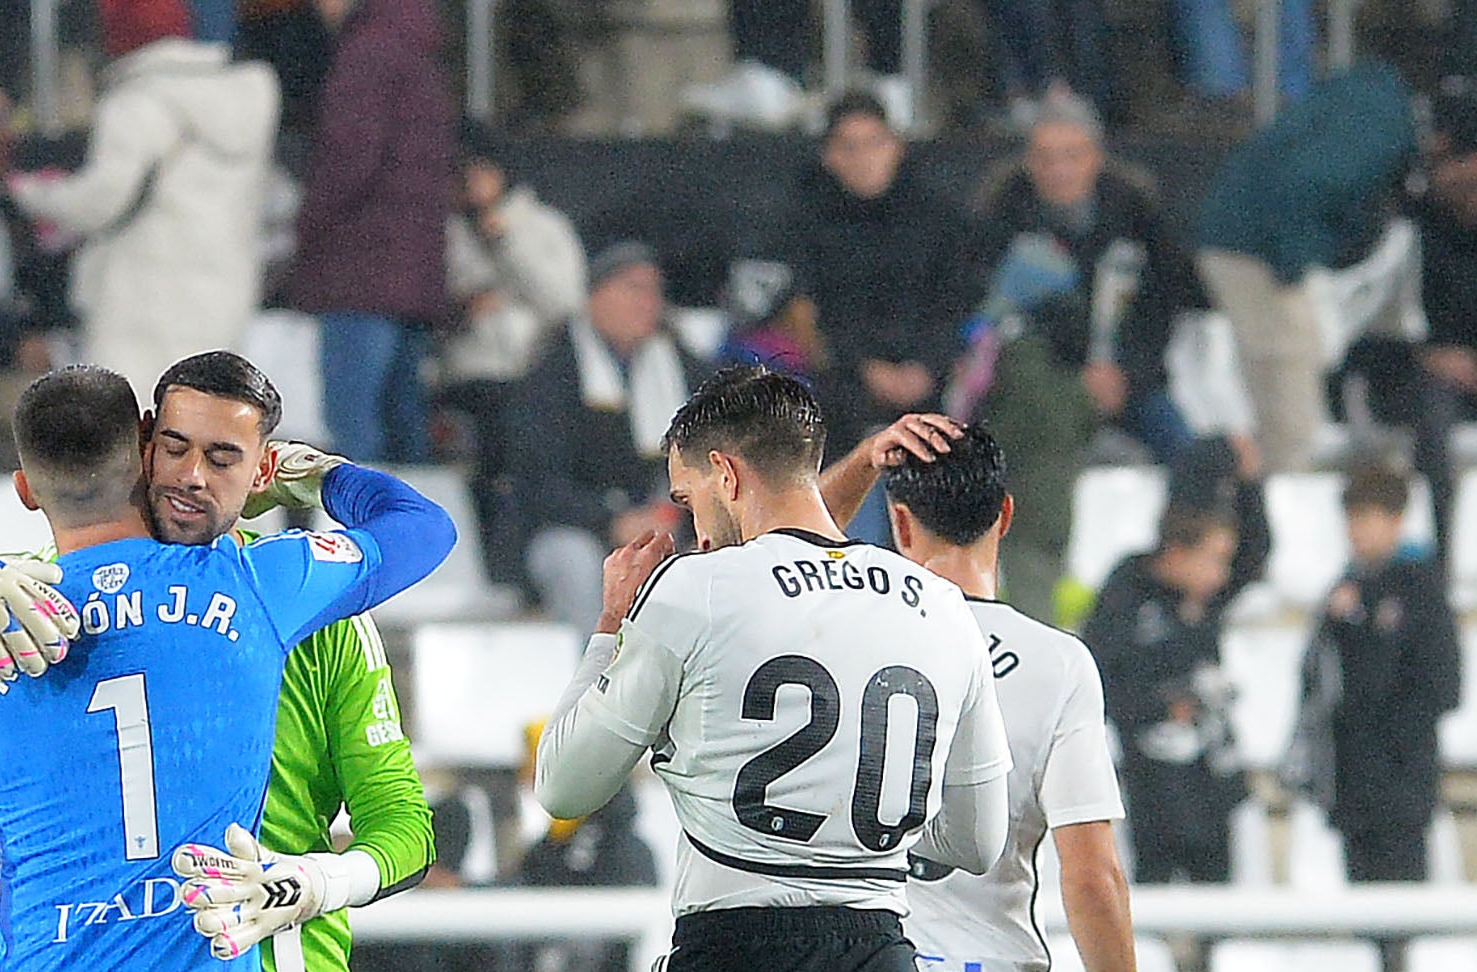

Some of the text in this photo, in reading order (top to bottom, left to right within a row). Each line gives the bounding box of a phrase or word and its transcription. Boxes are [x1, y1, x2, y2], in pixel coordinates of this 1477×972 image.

[158, 586, 240, 642] J.R.
[772, 560, 927, 618] GREGO S.
[86, 672, 158, 860] 1
[732, 654, 939, 852] 20
[51, 876, 198, 944] IZAD
